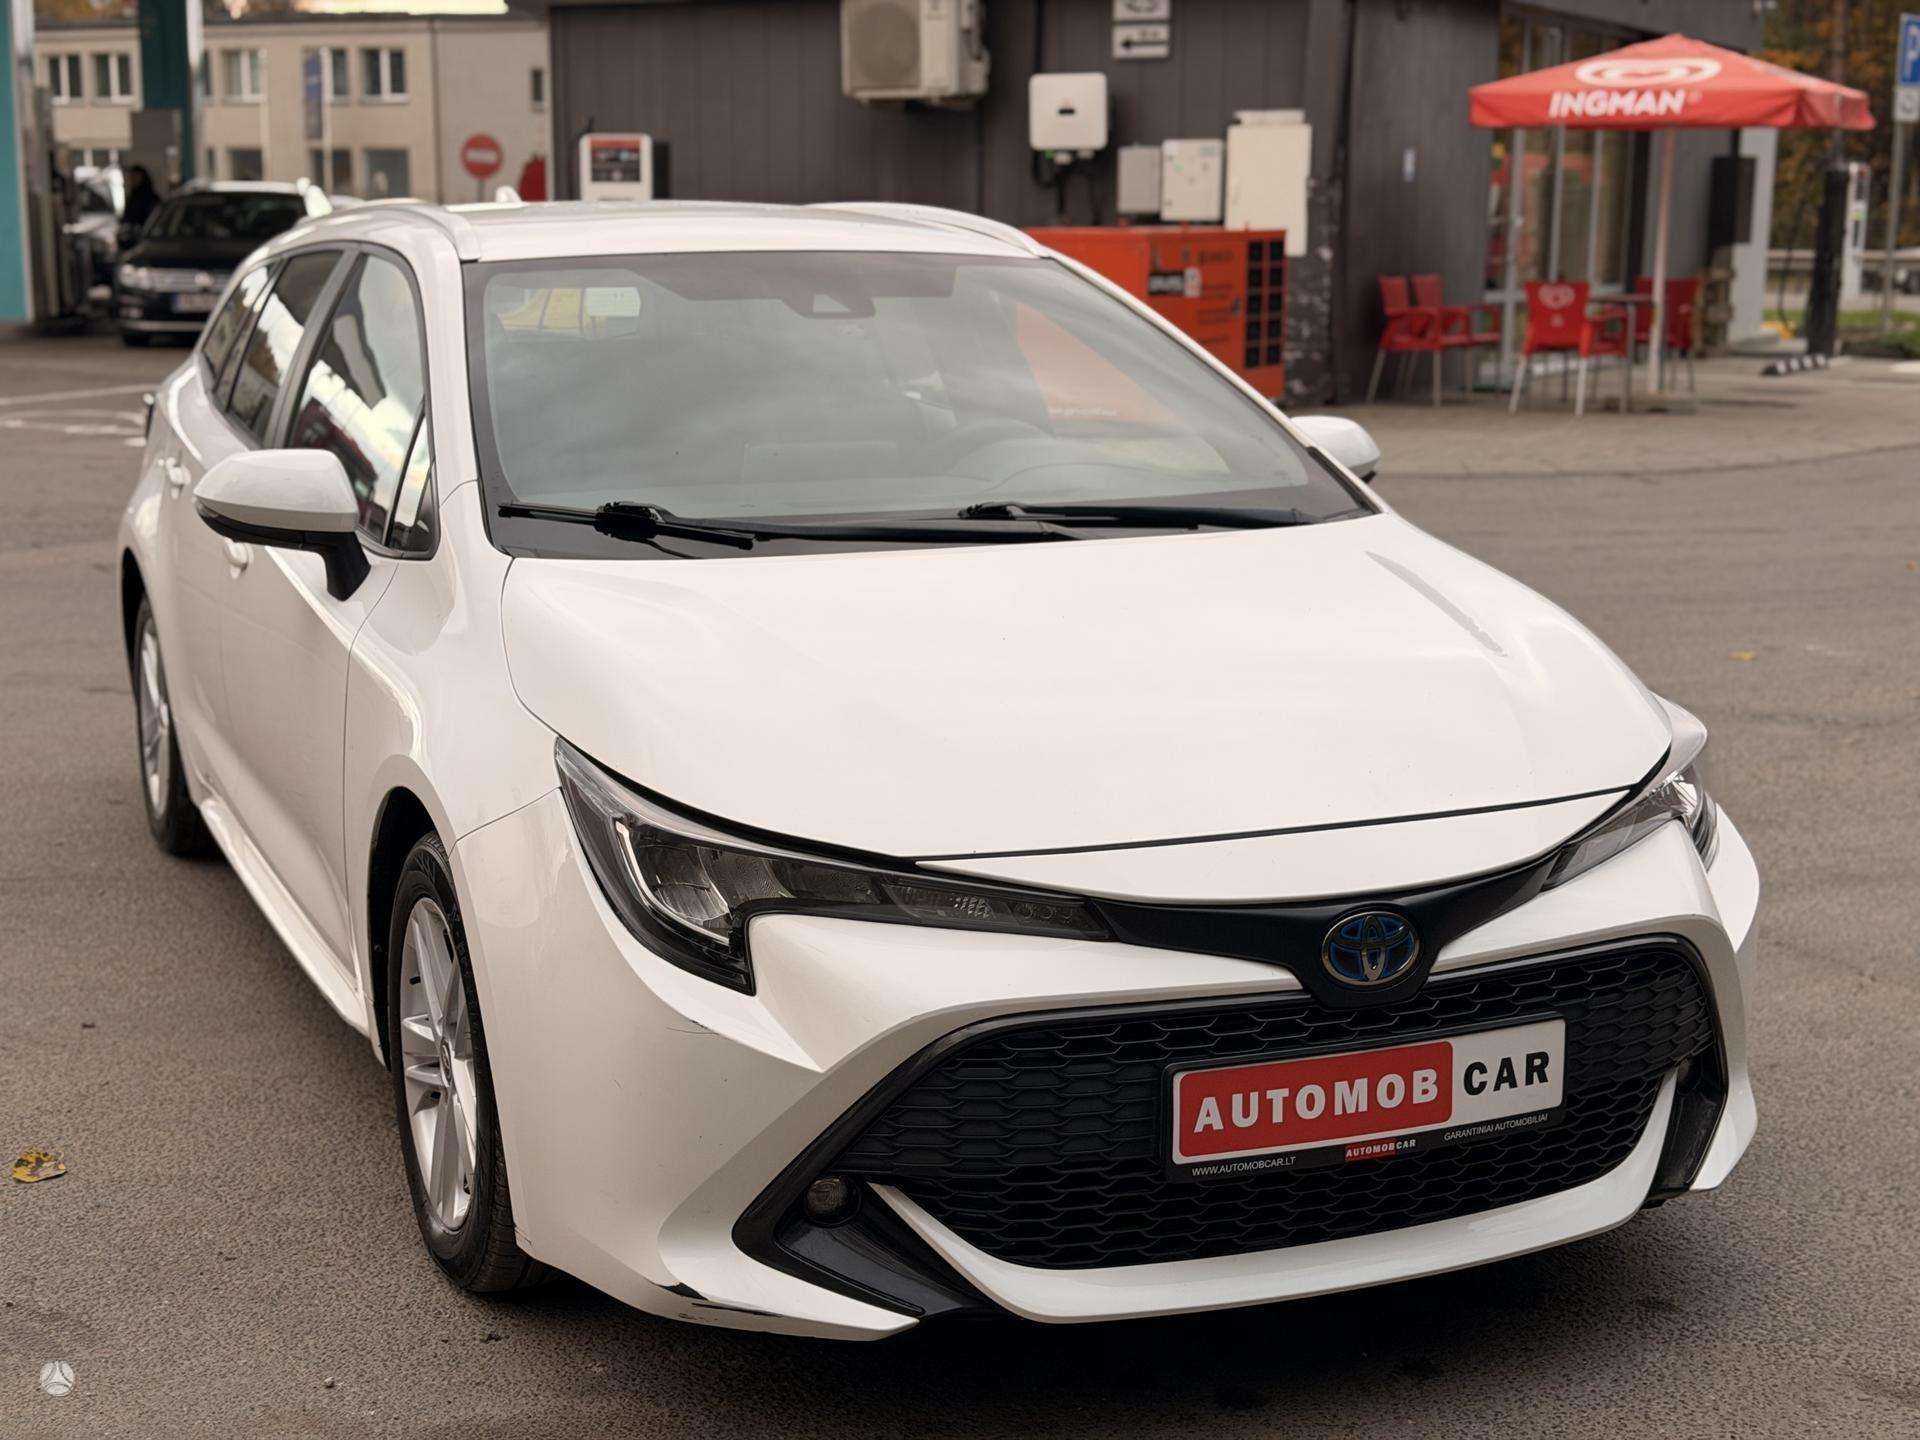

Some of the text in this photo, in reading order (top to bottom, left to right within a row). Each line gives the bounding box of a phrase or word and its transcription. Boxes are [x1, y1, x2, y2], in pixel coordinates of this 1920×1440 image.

[1549, 89, 1686, 118] INGMAN
[1463, 1051, 1550, 1096] CAR
[1444, 1113, 1549, 1142] GARANTINIAI AUTOMOBILIAI
[1192, 1156, 1297, 1177] WWW.AUTOMOBCAR.LT
